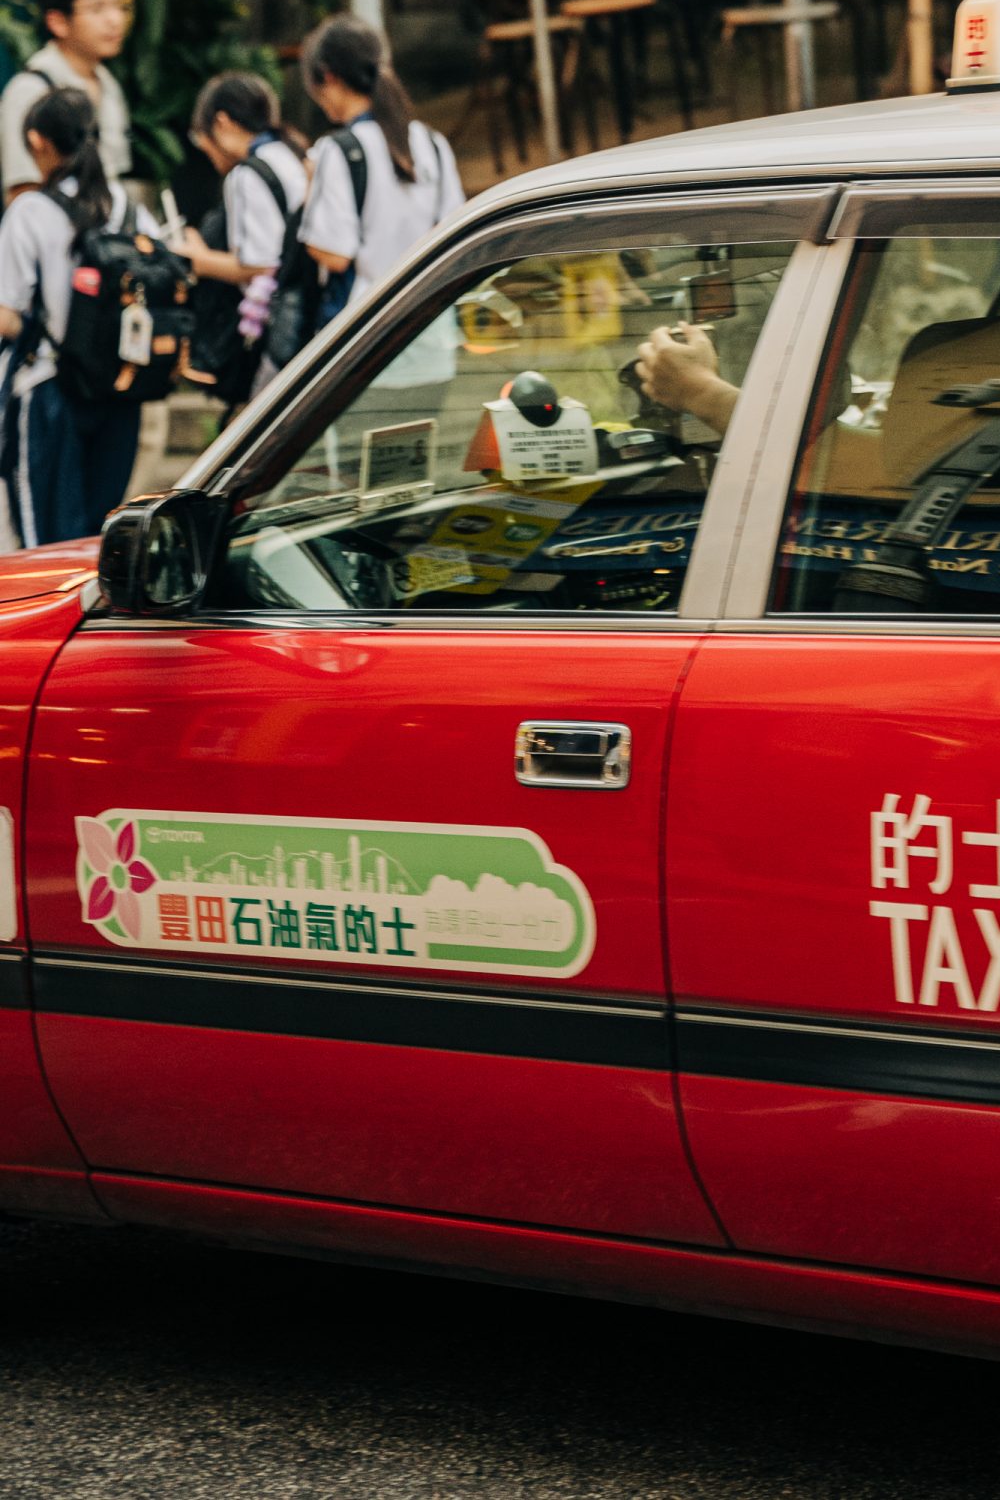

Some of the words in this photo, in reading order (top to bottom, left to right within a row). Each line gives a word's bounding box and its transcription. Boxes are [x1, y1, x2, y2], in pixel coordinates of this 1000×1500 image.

[157, 892, 417, 958] 豐田石油氣的士
